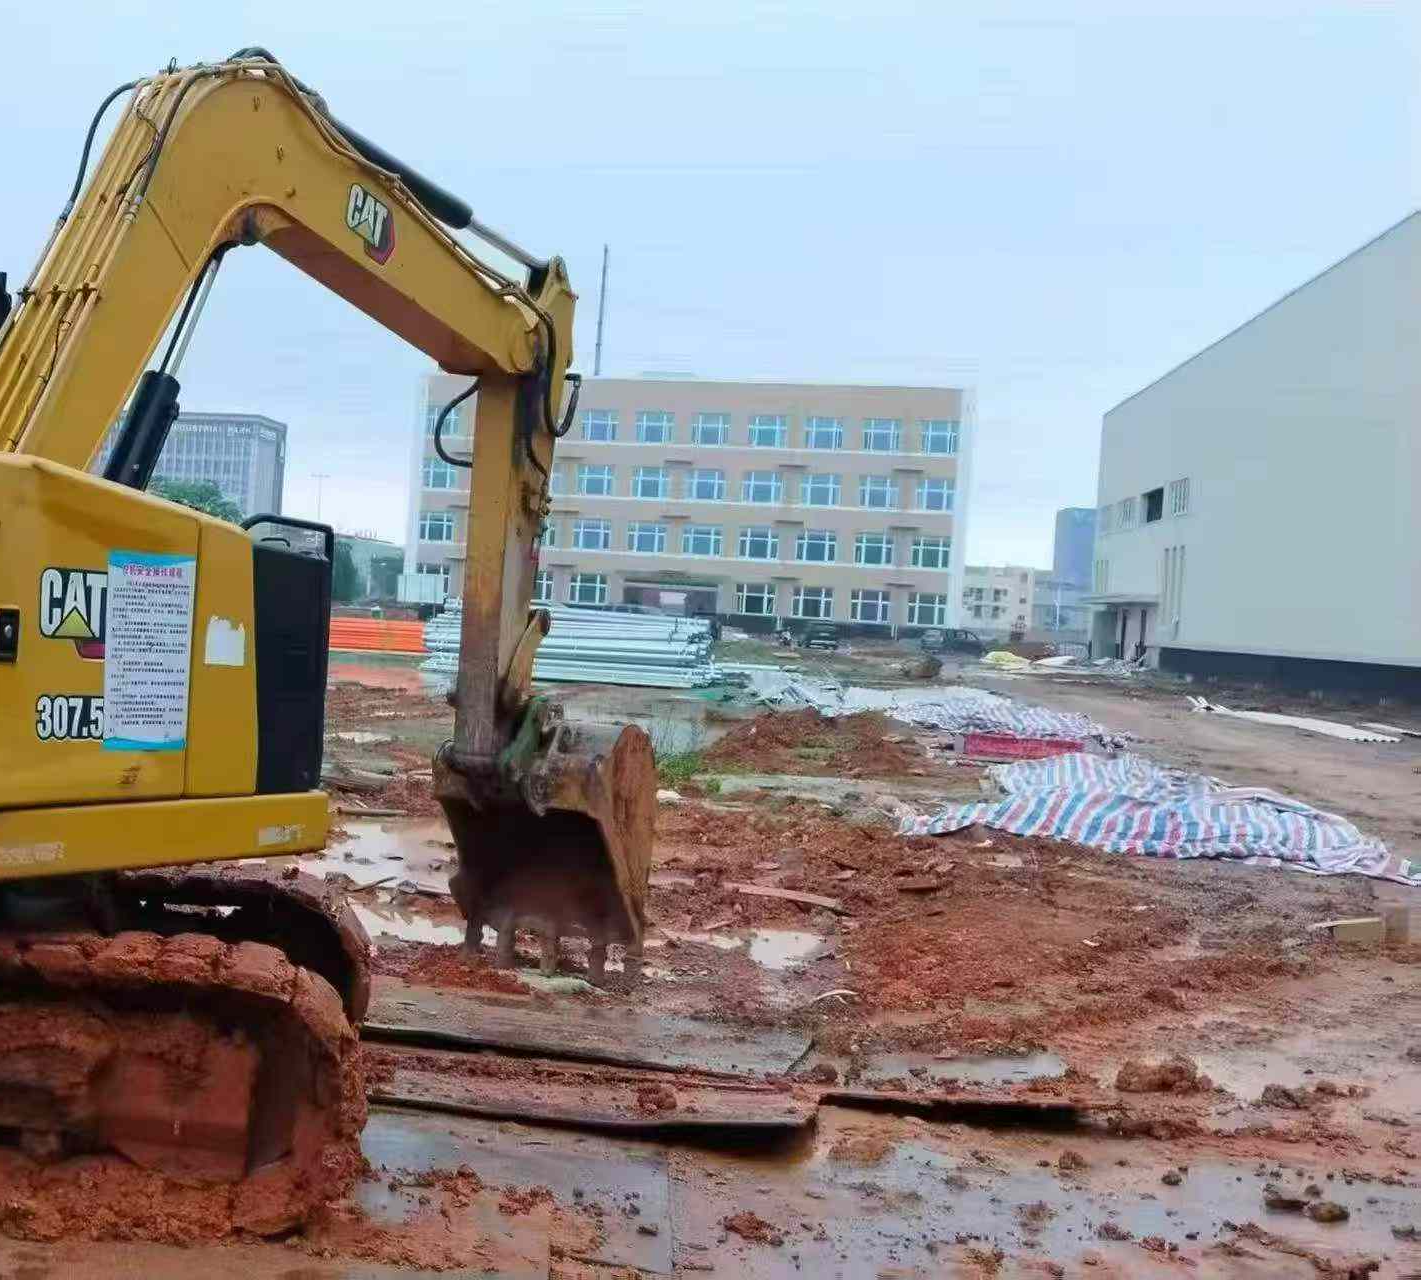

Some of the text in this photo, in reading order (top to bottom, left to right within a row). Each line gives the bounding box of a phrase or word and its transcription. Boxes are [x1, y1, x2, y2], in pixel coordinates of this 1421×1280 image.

[347, 184, 388, 247] CAT
[171, 424, 222, 433] NDUSTRIAL
[40, 568, 108, 638] CAT
[36, 695, 104, 739] 307.5
